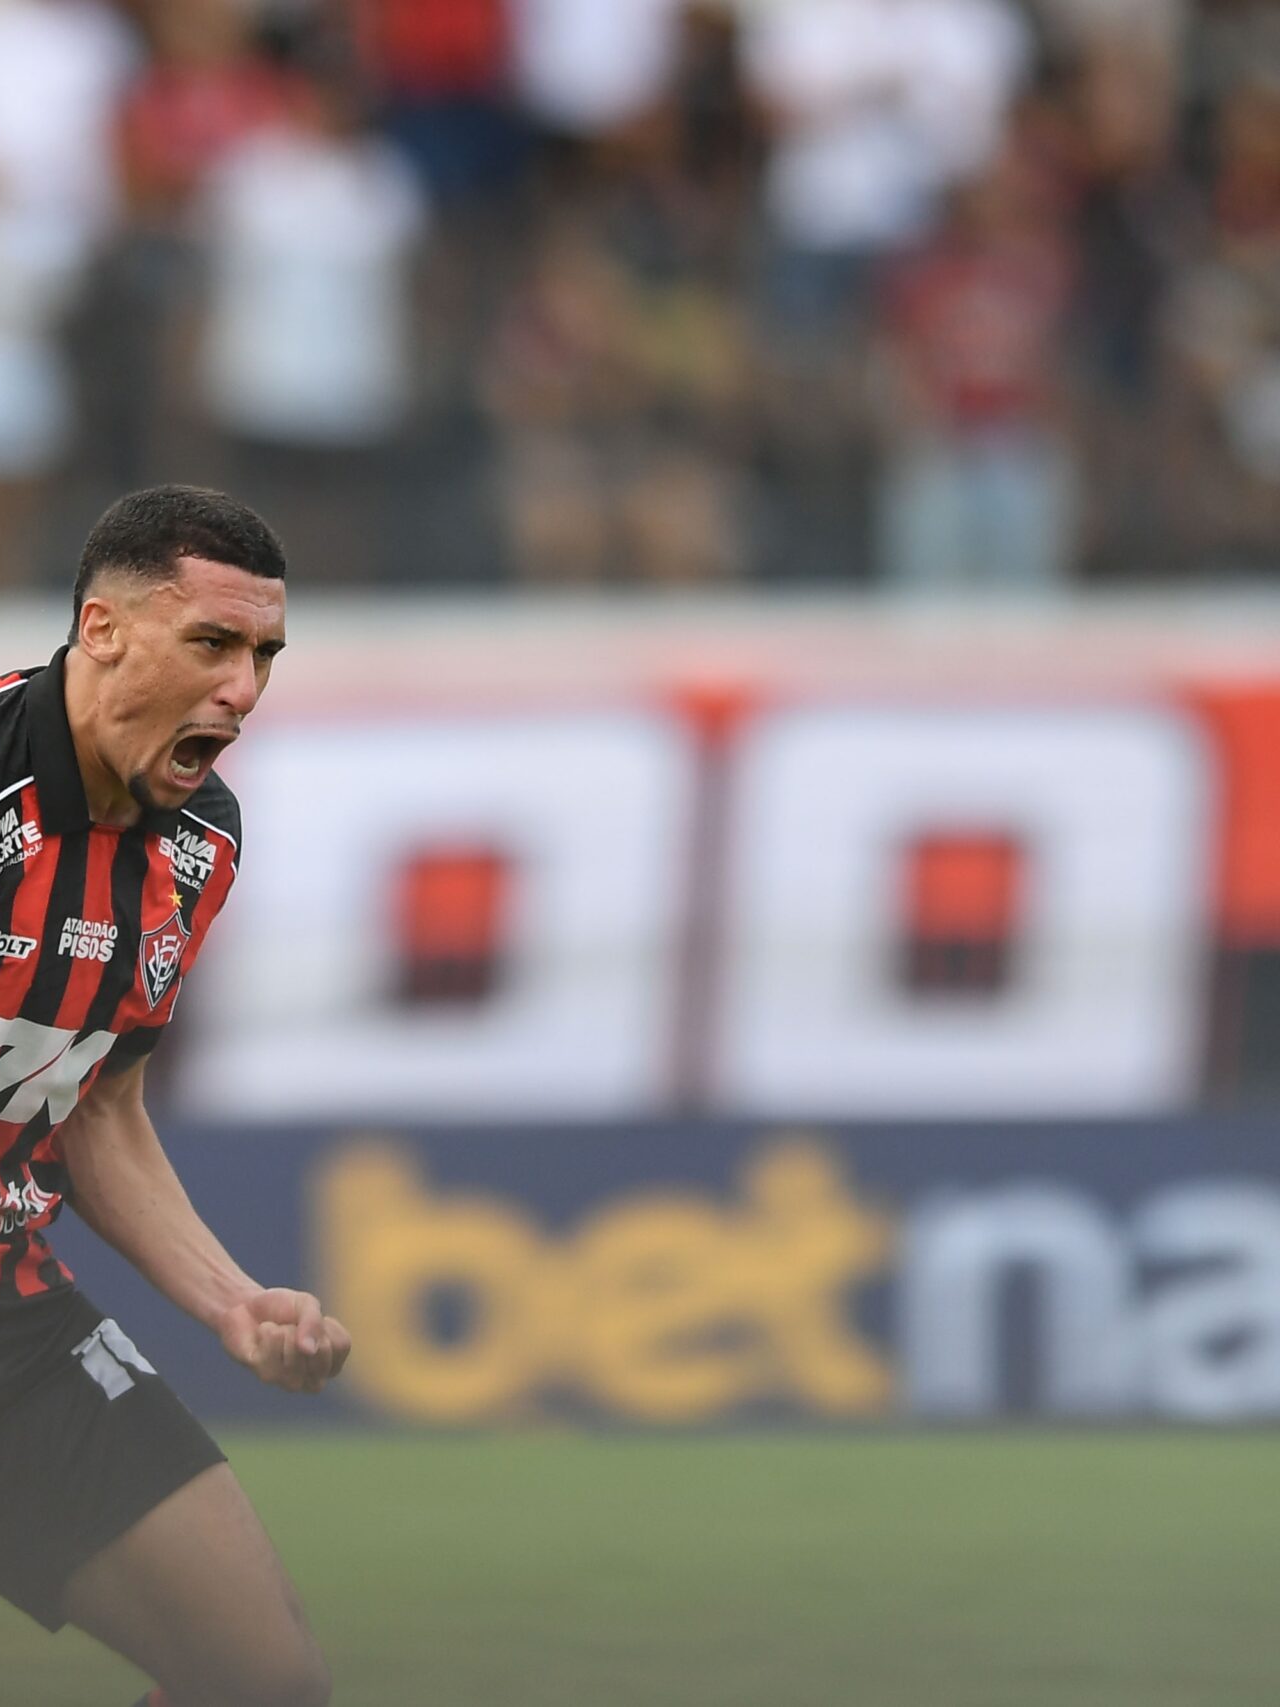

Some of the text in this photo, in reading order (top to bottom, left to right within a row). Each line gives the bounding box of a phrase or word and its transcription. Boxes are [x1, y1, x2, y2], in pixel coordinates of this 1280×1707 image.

[158, 836, 215, 880] SORT
[175, 825, 217, 863] VIVA
[58, 933, 115, 963] PISOS
